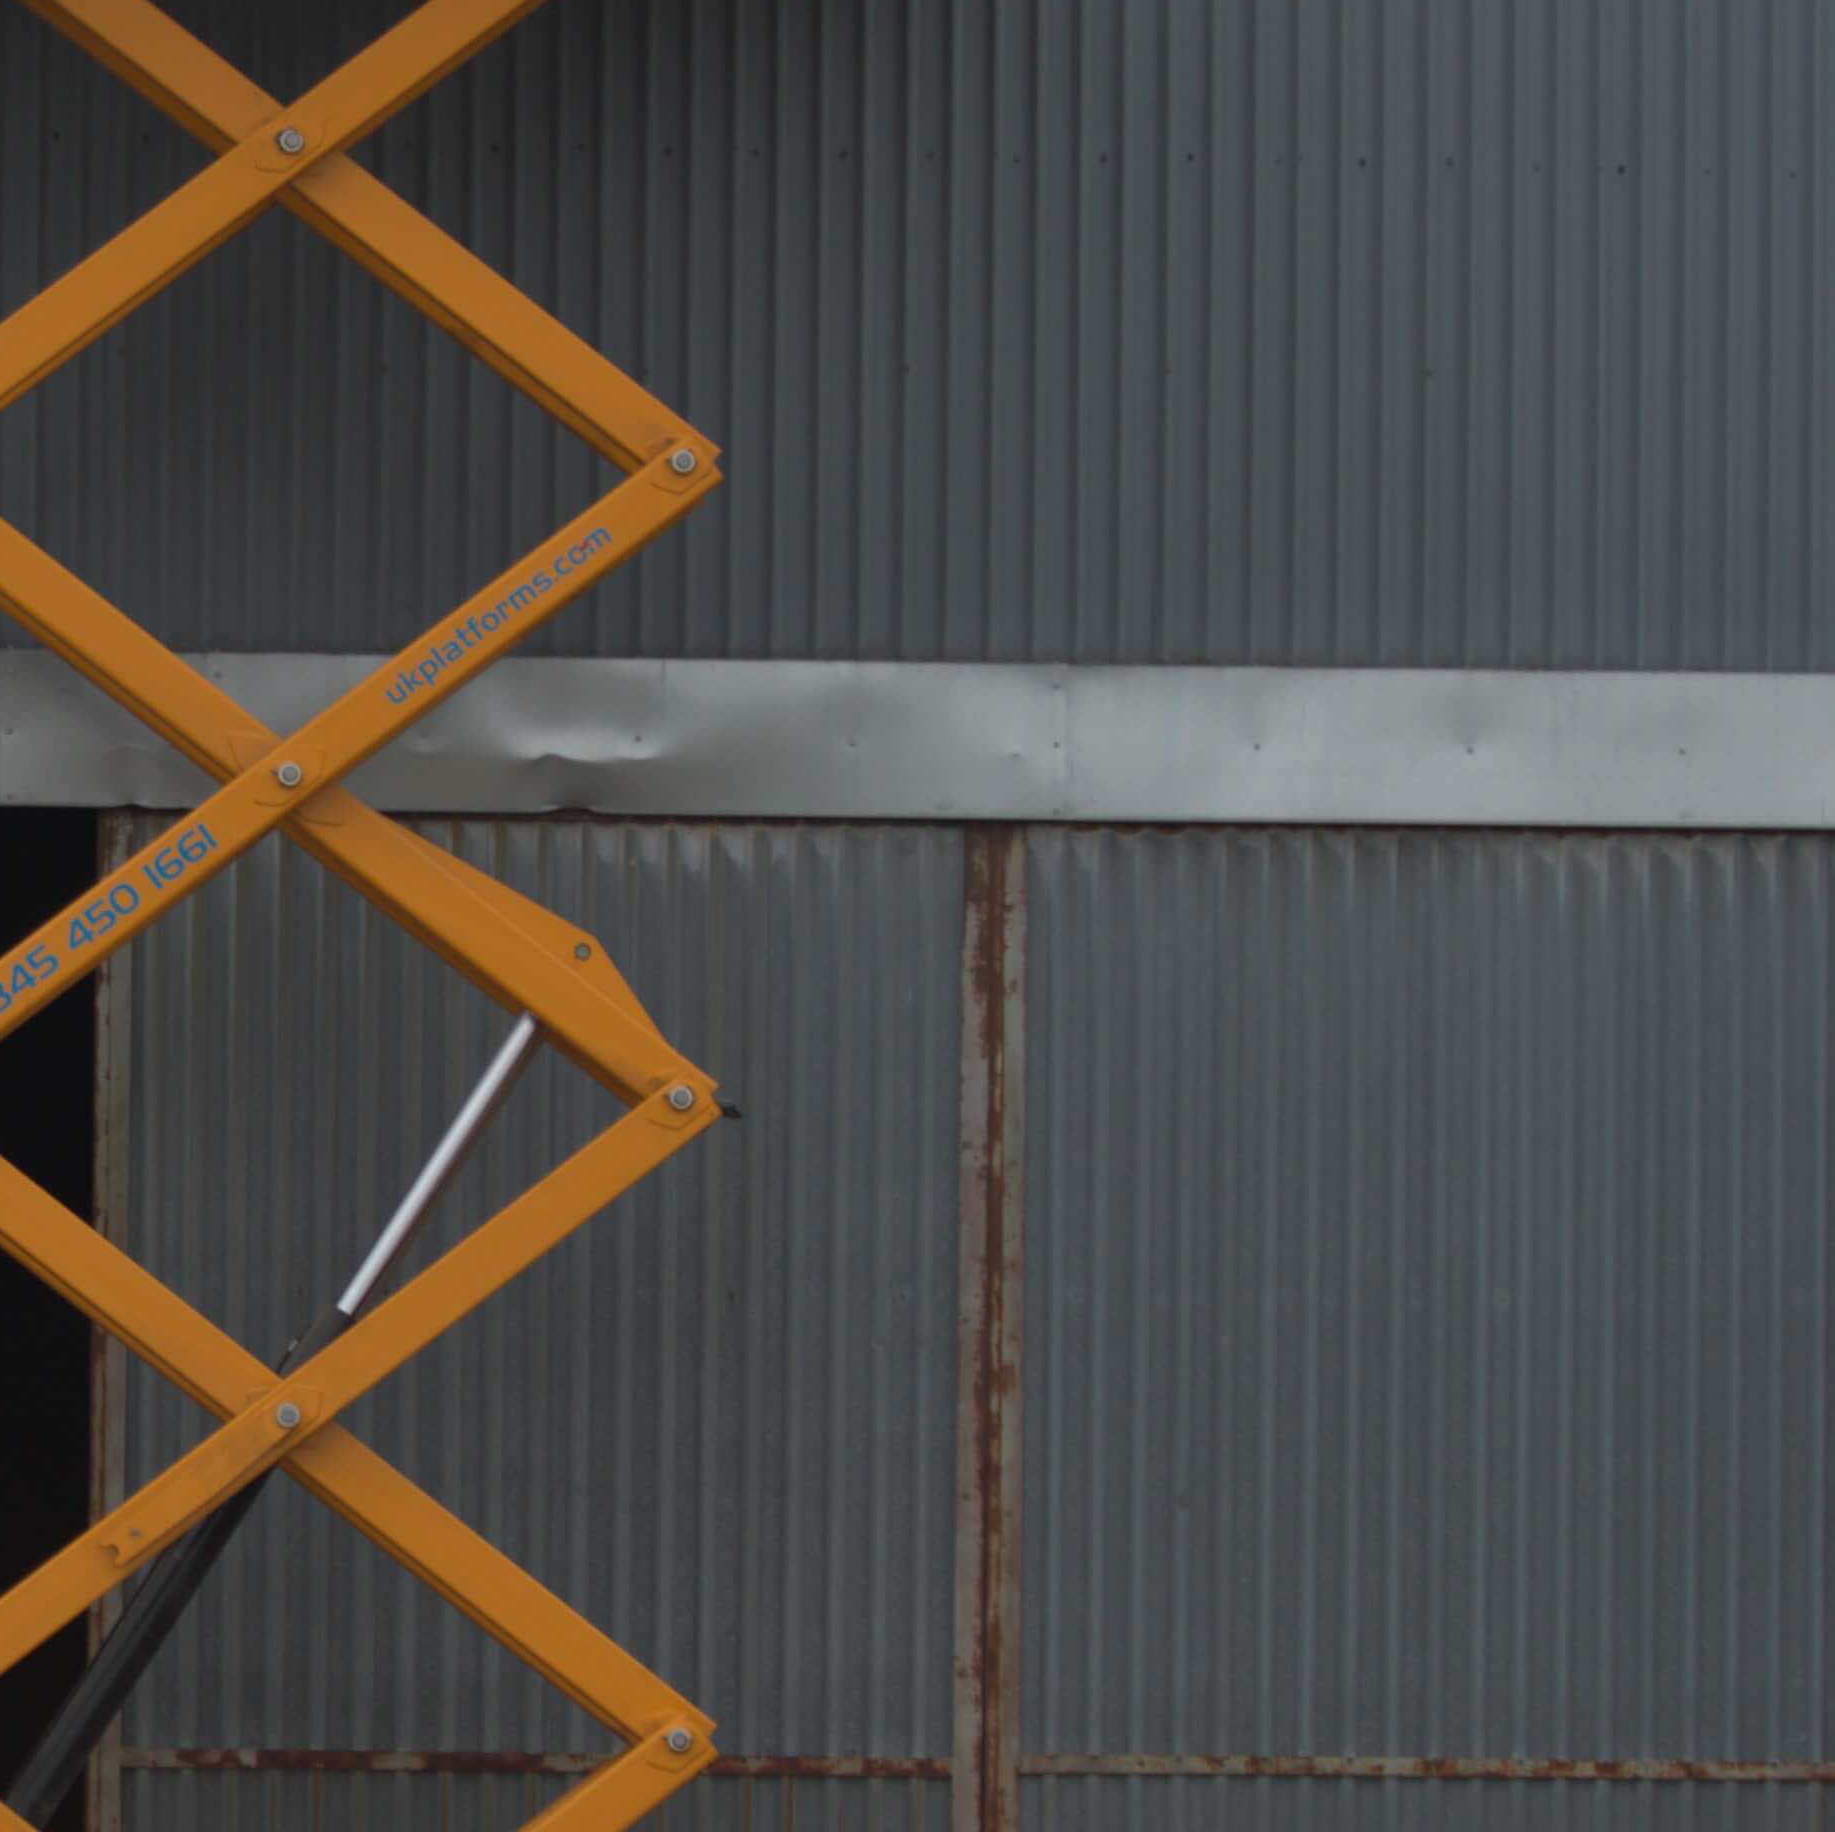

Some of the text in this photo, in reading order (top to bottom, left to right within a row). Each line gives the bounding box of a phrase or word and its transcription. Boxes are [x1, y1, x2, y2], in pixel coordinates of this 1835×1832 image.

[385, 526, 613, 705] ukplatforms.com
[67, 882, 141, 952] 450
[142, 821, 219, 890] 1661
